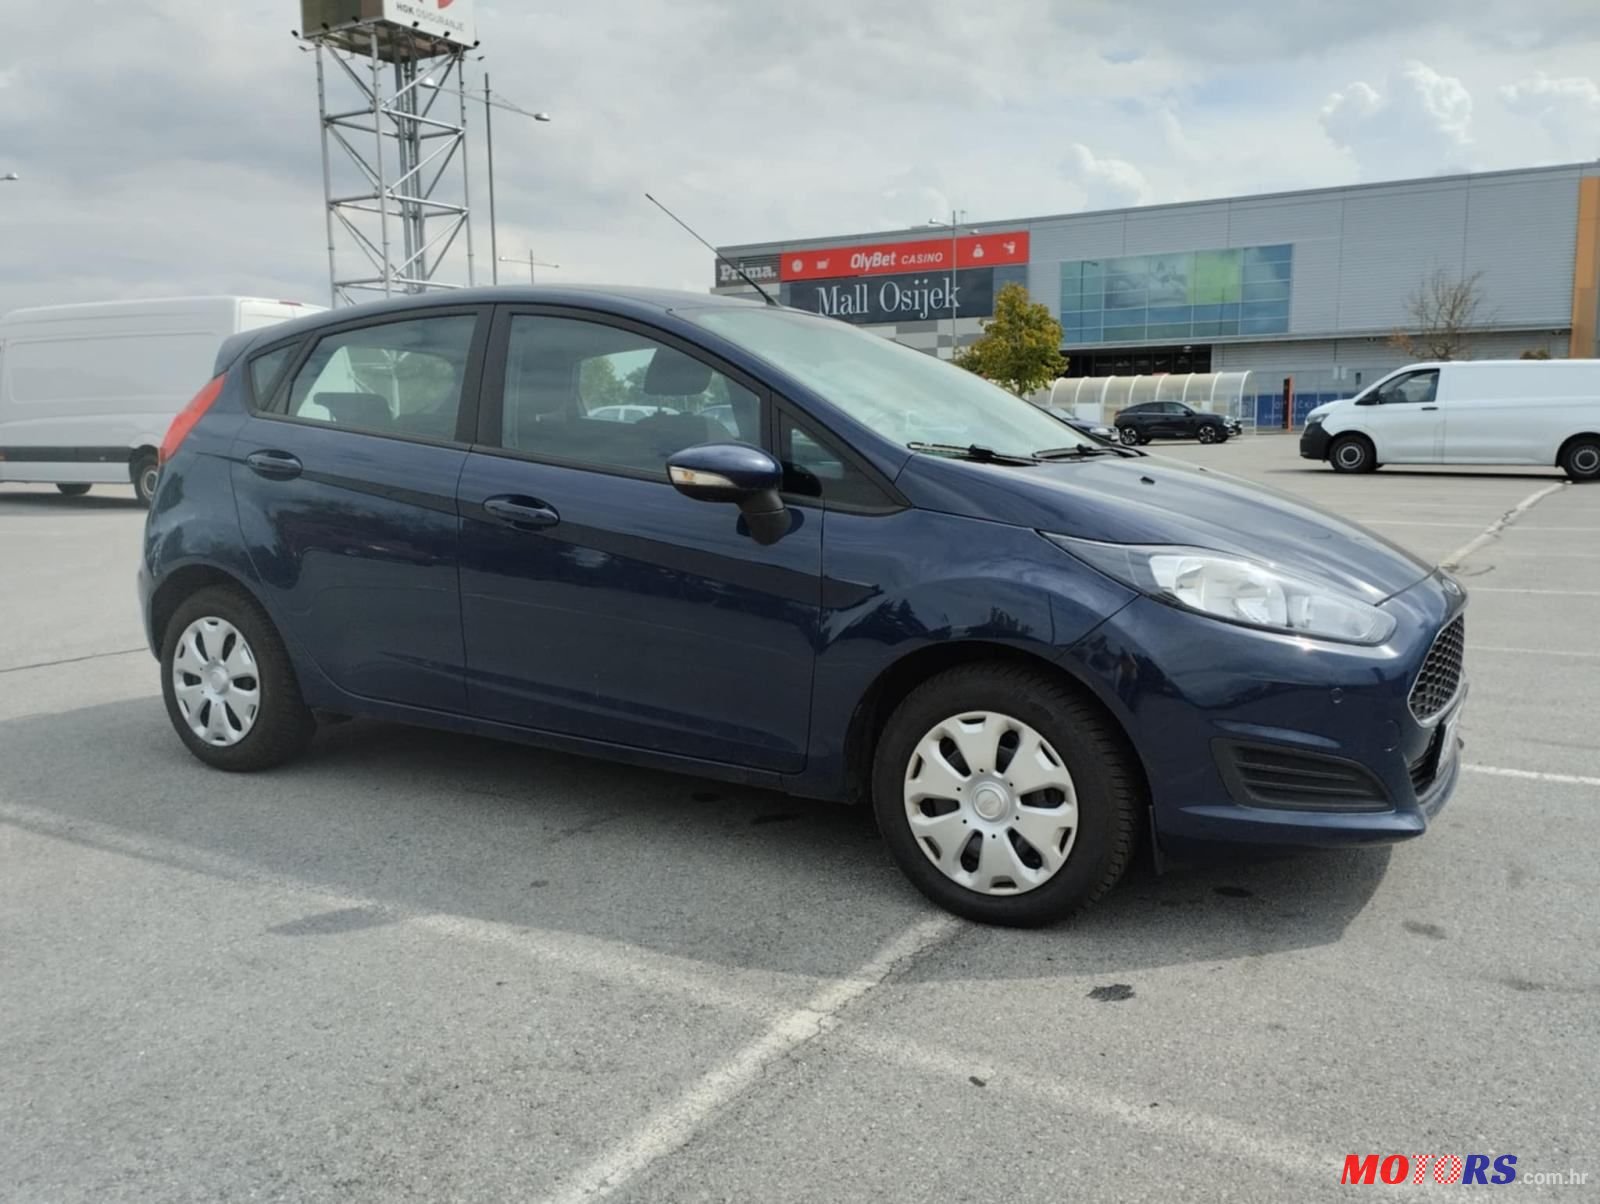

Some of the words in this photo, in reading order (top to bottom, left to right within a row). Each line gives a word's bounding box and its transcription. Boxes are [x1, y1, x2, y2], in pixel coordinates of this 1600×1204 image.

[850, 251, 896, 271] OlyBet
[901, 252, 943, 265] CASINO
[816, 283, 869, 316] Mall
[879, 277, 960, 319] Osijek
